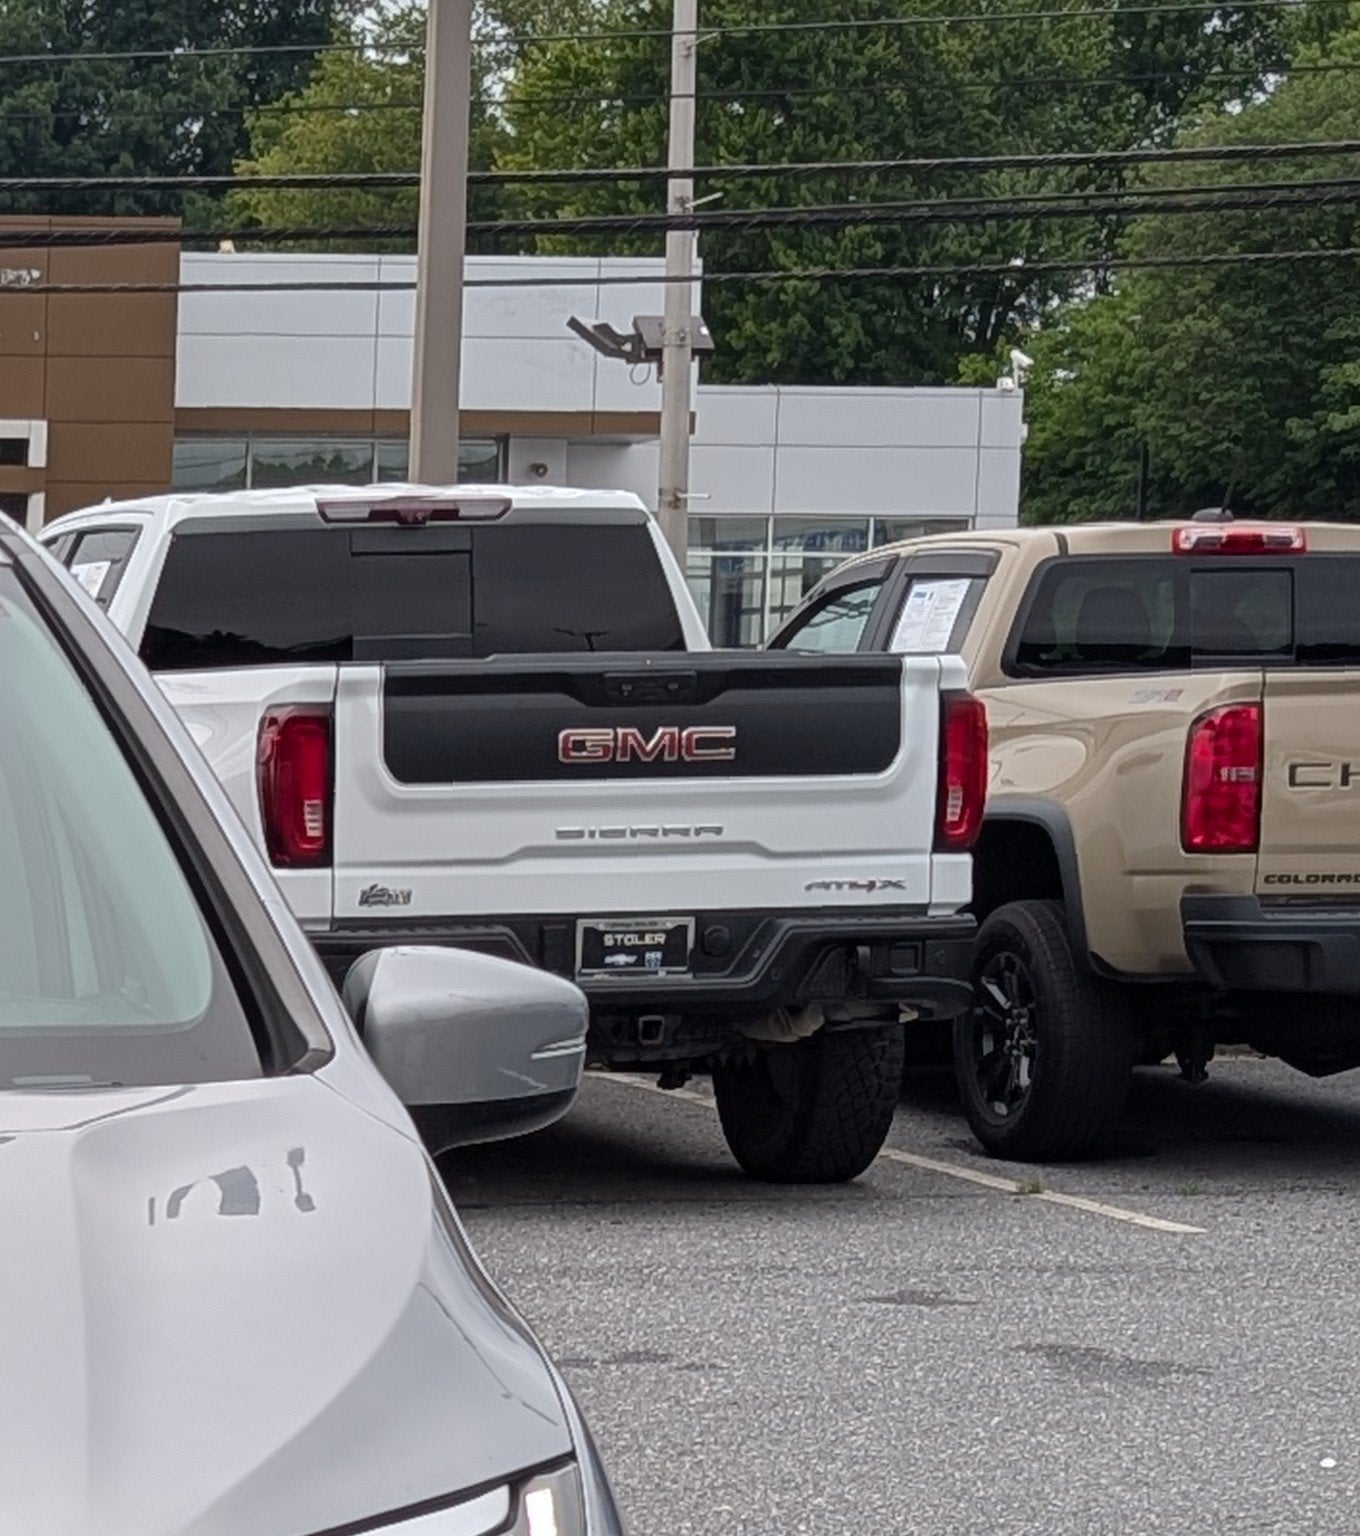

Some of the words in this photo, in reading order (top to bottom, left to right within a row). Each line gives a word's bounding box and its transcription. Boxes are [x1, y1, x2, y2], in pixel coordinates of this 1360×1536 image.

[558, 726, 736, 763] GMC
[555, 824, 724, 840] SIERRA
[603, 932, 666, 947] STOLER
